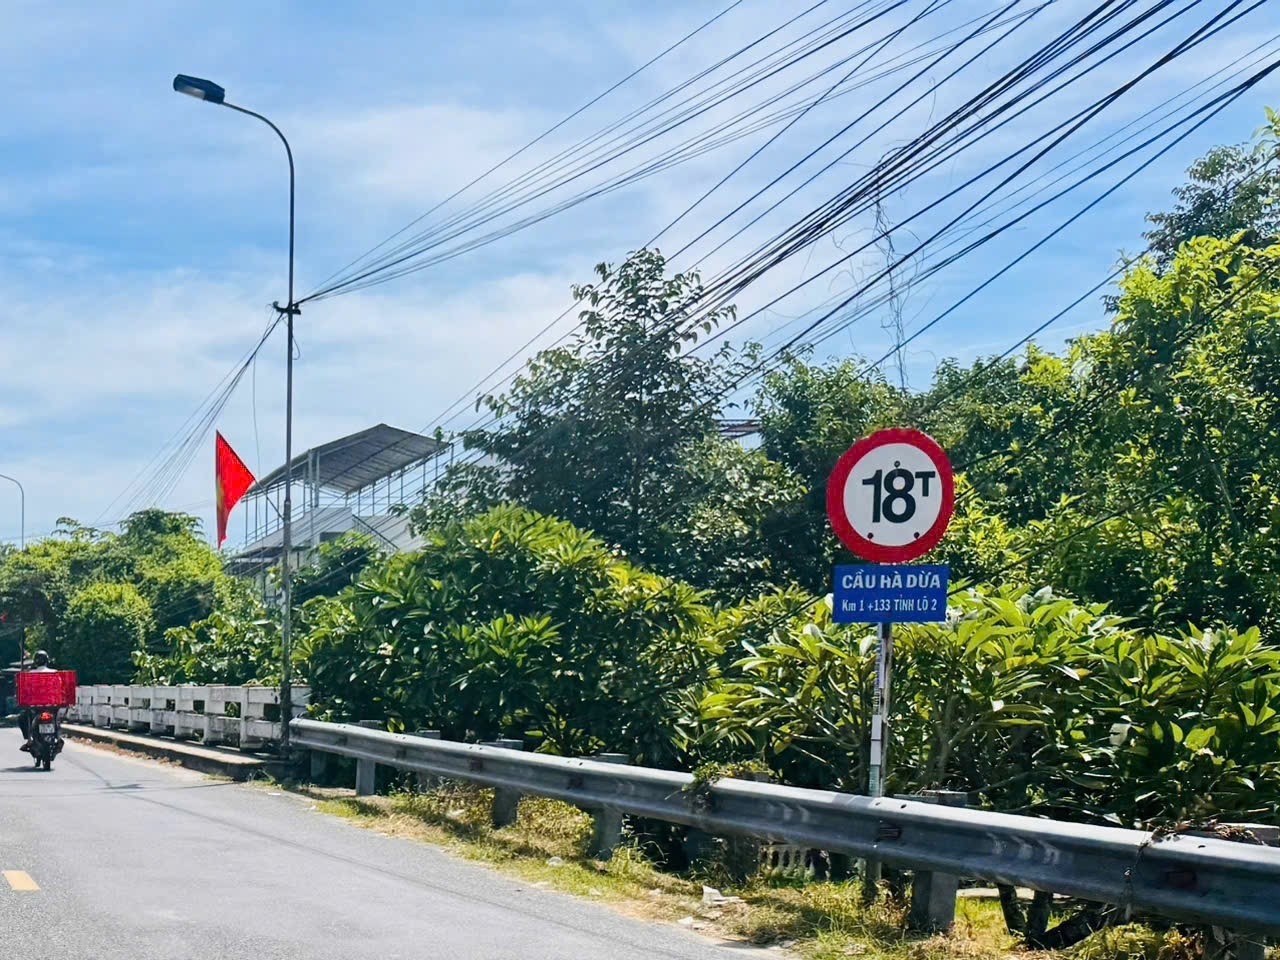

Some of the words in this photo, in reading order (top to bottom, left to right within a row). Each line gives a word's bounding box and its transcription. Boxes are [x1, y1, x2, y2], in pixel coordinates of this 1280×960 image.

[841, 568, 876, 589] CẦU
[880, 570, 903, 588] HÀ
[906, 570, 941, 588] DỪA
[842, 599, 856, 612] Km
[894, 594, 914, 612] TỈNH
[917, 596, 928, 613] LỘ
[931, 598, 938, 611] 2
